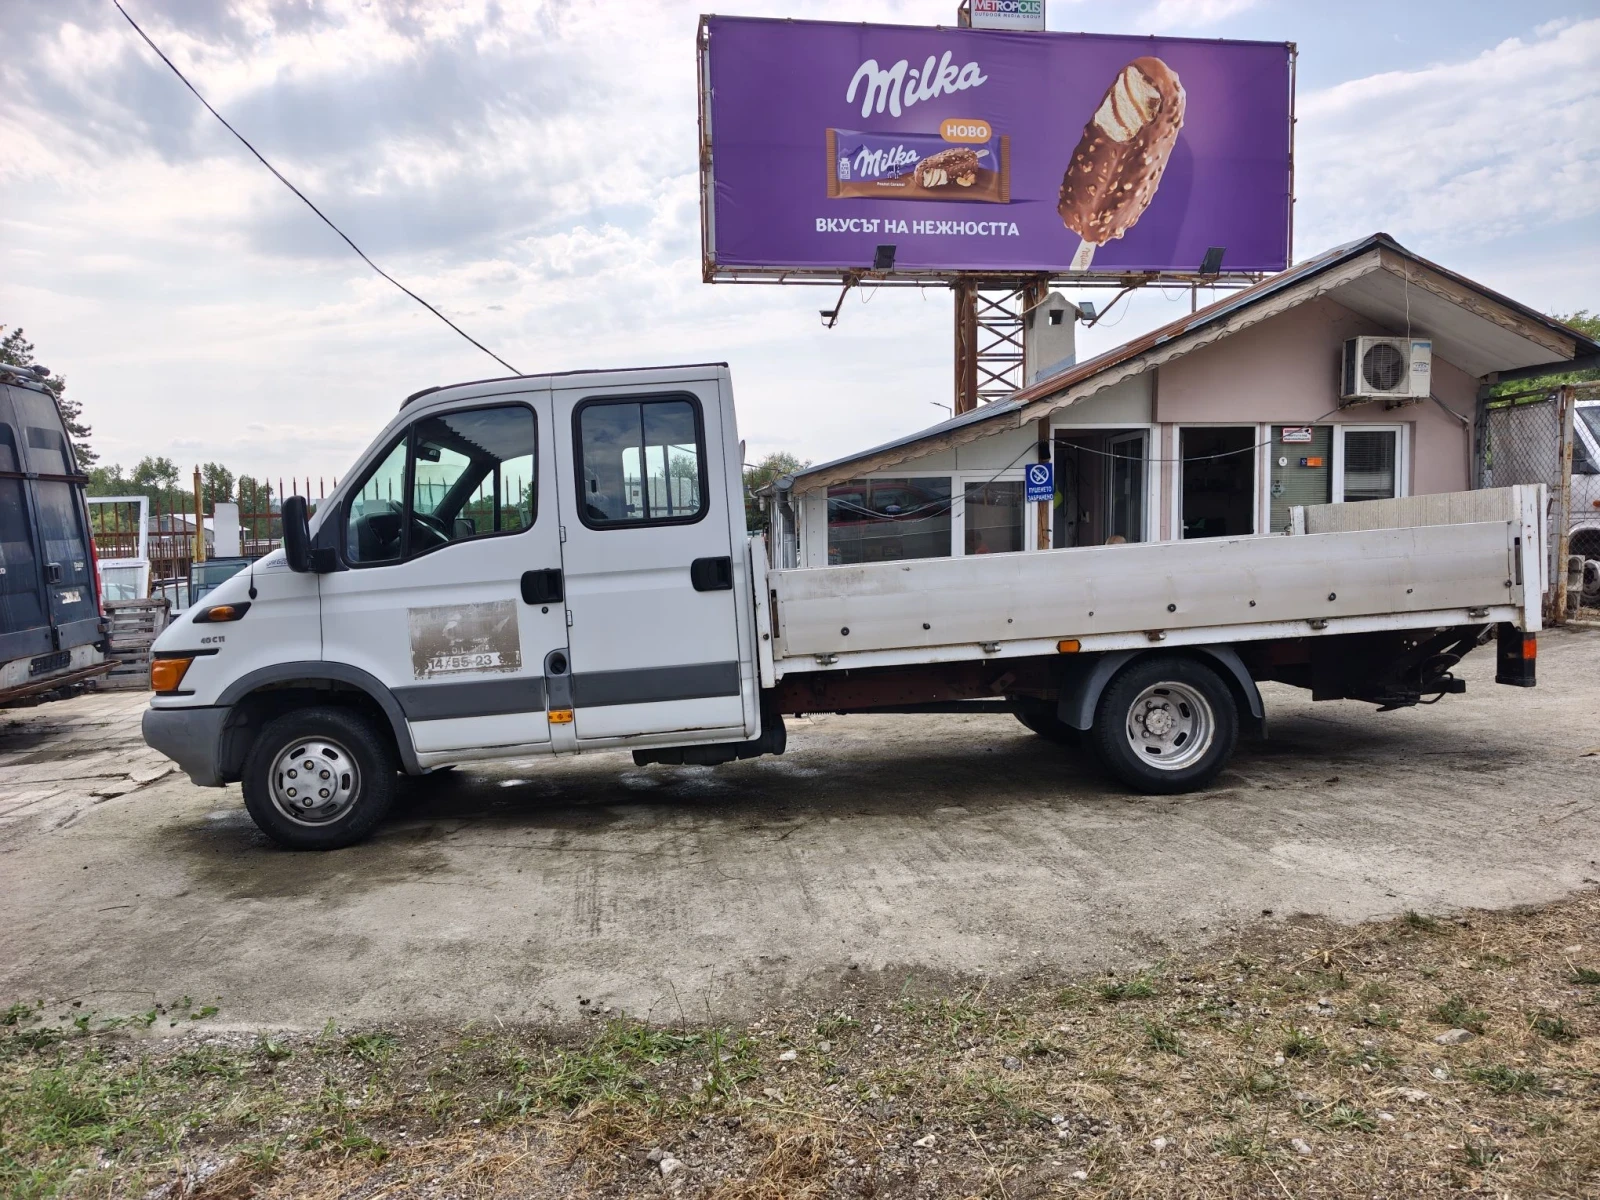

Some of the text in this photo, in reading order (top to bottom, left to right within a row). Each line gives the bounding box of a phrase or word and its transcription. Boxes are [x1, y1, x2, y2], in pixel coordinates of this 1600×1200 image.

[975, 0, 1040, 14] METROPOLIS
[846, 50, 988, 118] Milka
[946, 125, 988, 138] НОВО
[853, 144, 920, 178] Milka
[815, 217, 1020, 236] ВКУСЪТ НА НЕЖНОСТТА
